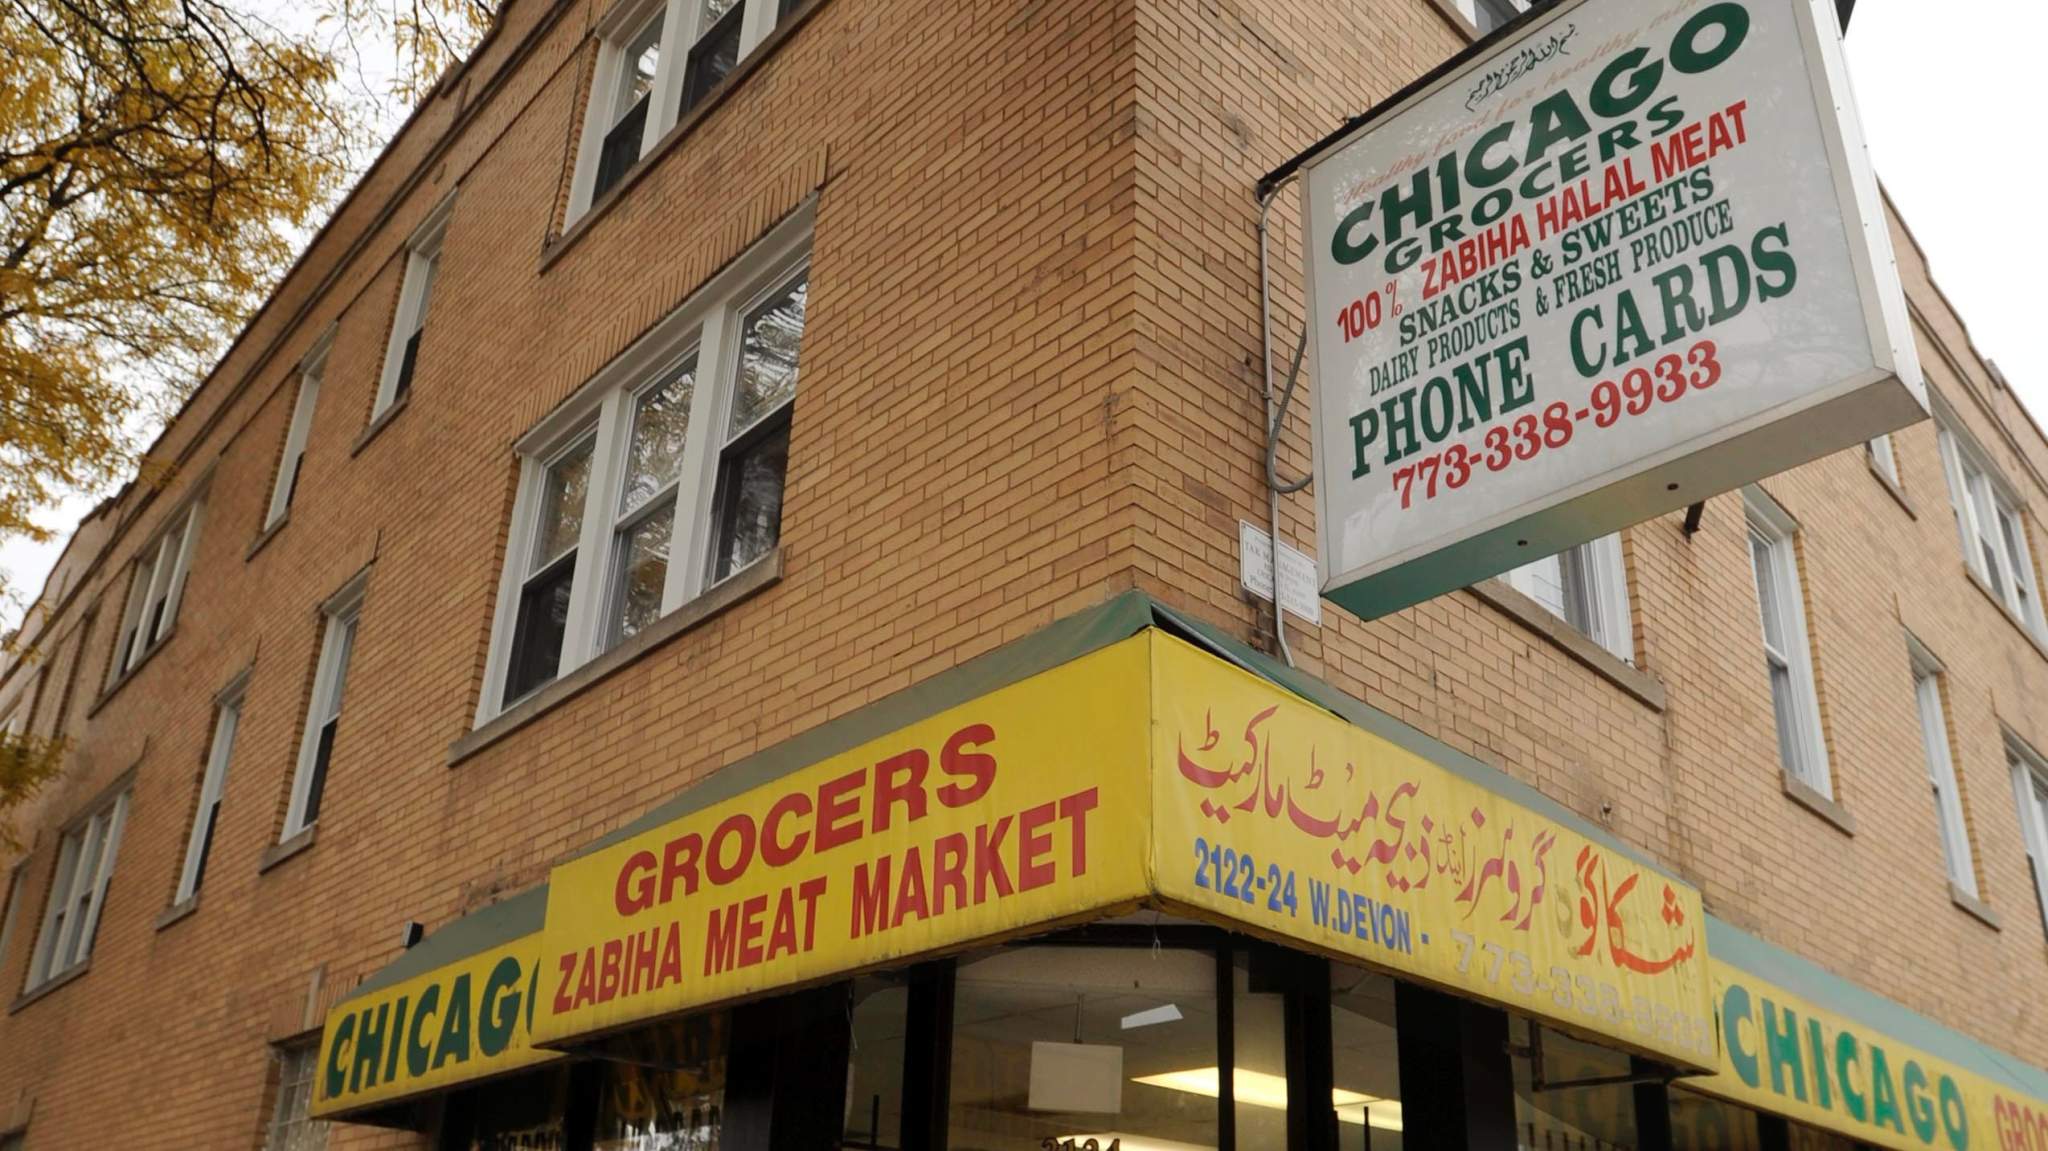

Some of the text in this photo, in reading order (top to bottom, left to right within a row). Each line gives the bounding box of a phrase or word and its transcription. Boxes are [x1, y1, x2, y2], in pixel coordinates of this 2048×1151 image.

[1331, 2, 1749, 265] CHICAGO
[1384, 95, 1684, 274] GROCERS
[1421, 213, 1531, 299] ZABIHA
[1536, 162, 1646, 240] HALAL
[1651, 101, 1746, 183] MEAT
[1370, 199, 1733, 396] DAIRY PRODUCTS & FRESH PRODUCE
[1400, 165, 1713, 347] SNACKS & SWEETS
[1349, 222, 1796, 480] PHONE CARDS
[1393, 340, 1720, 508] 773-338-9933
[551, 785, 1101, 1015] ZABIHA MEAT MARKET
[613, 721, 998, 918] GROCERS
[1194, 838, 1298, 917] 2122-24
[326, 956, 540, 1099] CHICAG
[1722, 984, 2048, 1151] CHICAGO GRO
